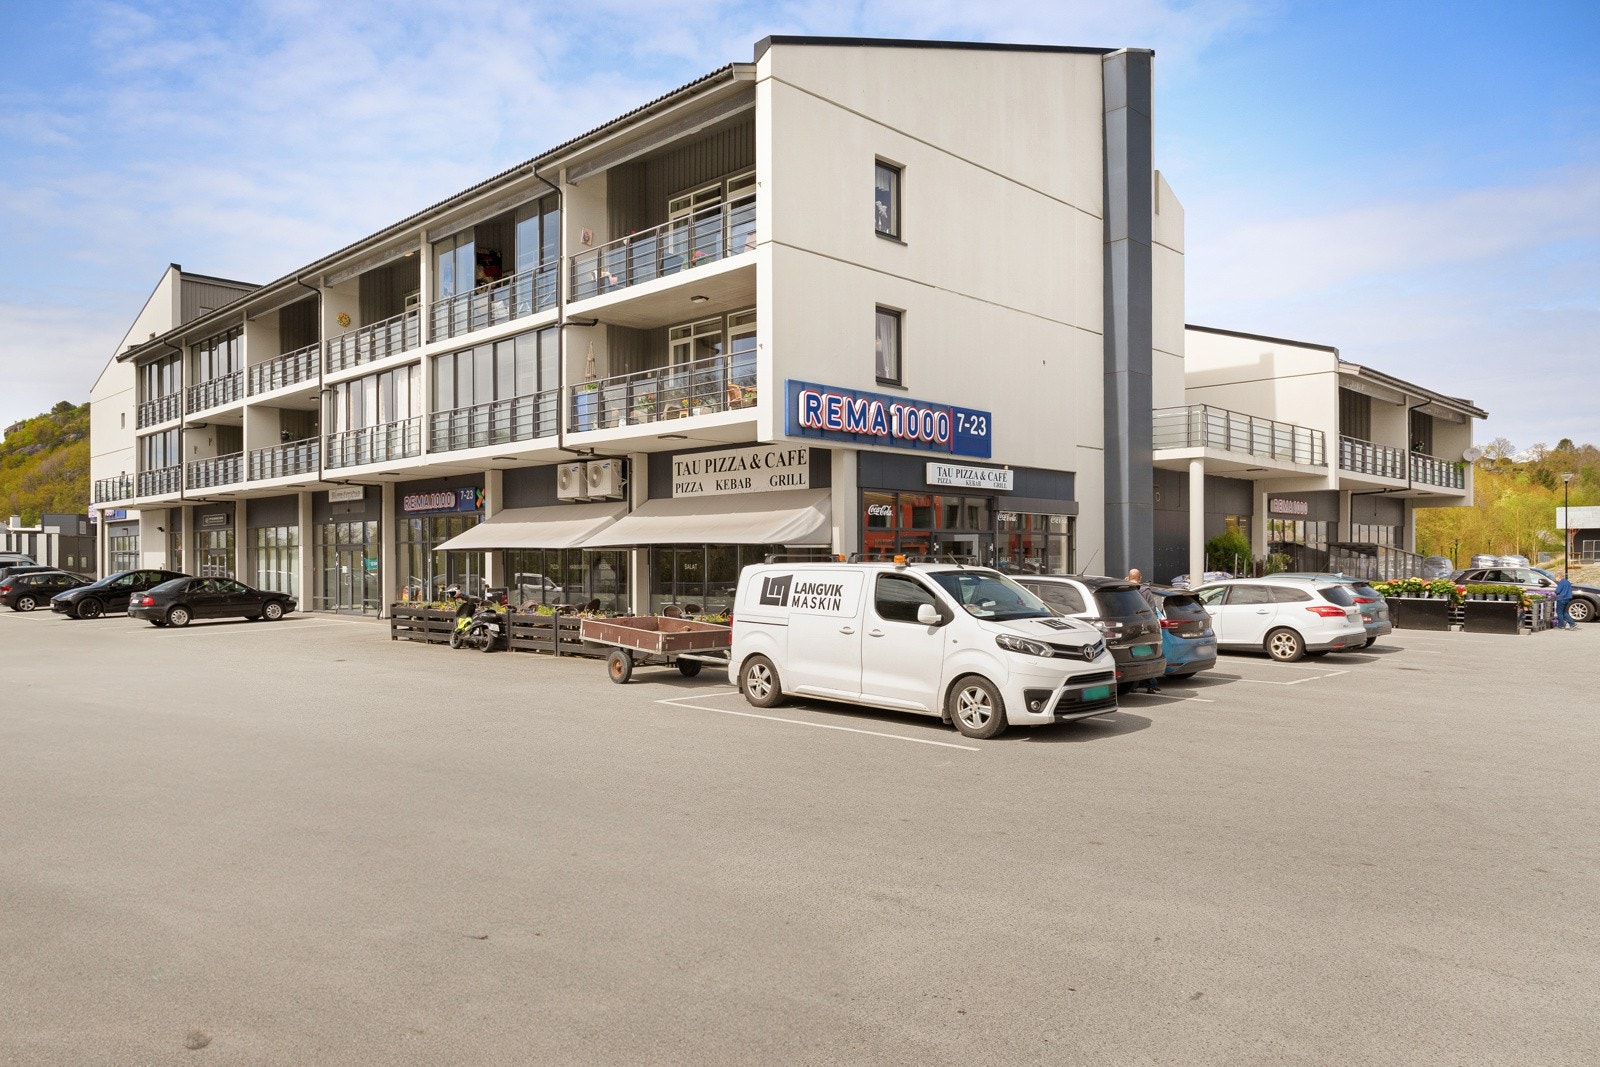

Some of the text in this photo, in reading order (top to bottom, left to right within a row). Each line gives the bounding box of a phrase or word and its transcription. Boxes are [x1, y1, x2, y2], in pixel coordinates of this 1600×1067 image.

[800, 390, 987, 444] REMA 1000 7-23
[675, 446, 807, 476] TAU PIZZA & CAFÉ
[675, 473, 806, 494] PIZZA KEBAB GRILL
[937, 467, 953, 477] TAU
[956, 468, 979, 480] PIZZA
[980, 471, 986, 480] &
[403, 490, 474, 511] REMA 1000 7-23
[794, 582, 843, 597] LANGVIK
[791, 596, 842, 611] MASKIN
